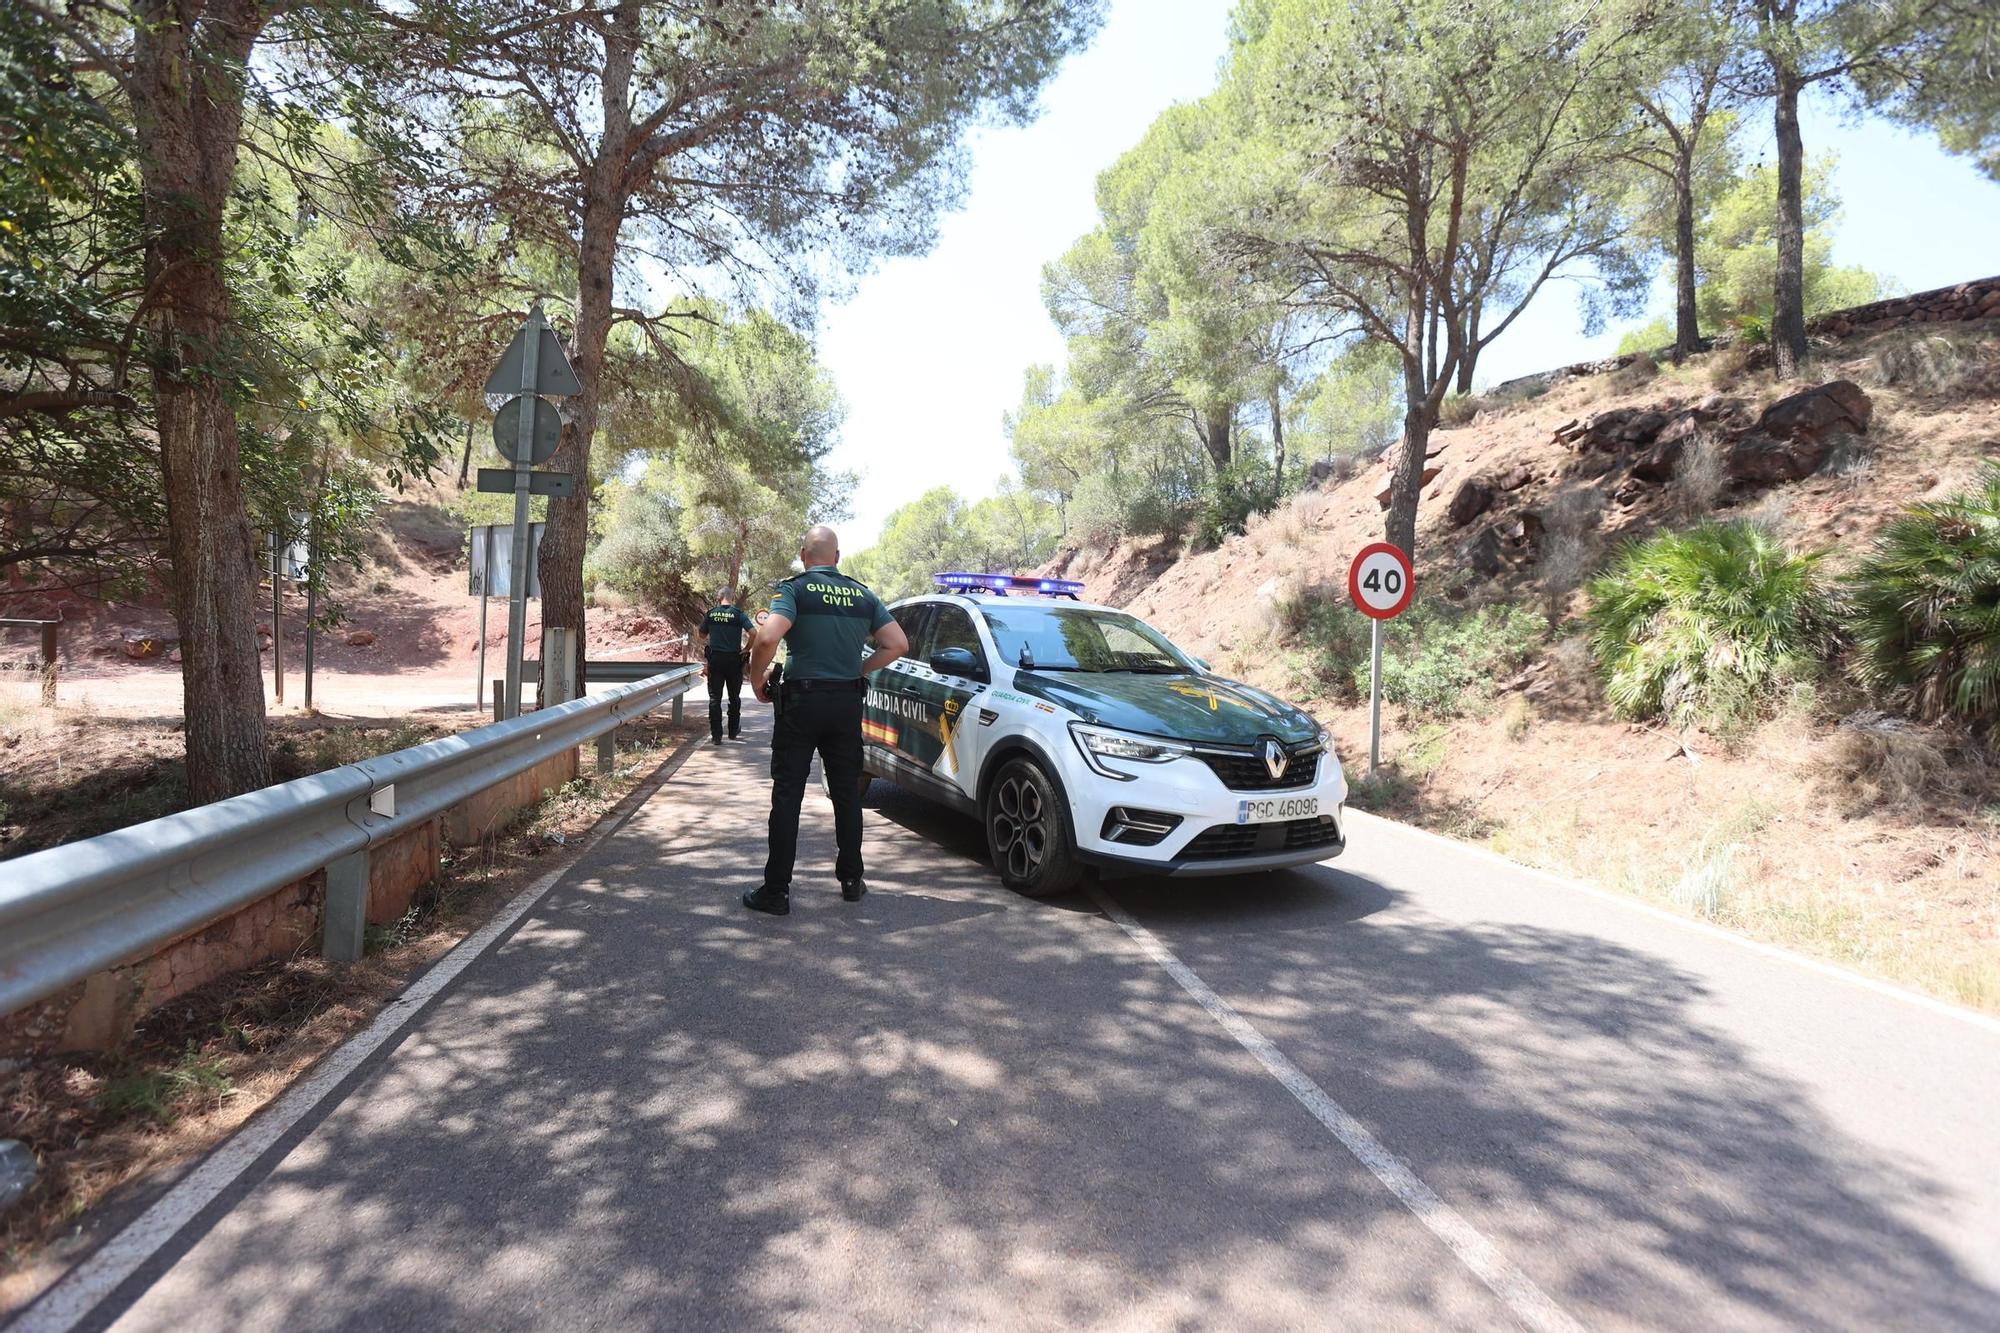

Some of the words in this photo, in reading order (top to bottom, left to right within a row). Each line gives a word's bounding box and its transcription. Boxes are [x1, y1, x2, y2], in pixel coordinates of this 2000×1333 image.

[806, 583, 864, 598] GUARDIA
[1363, 568, 1401, 594] 40
[822, 594, 854, 607] CIVIL
[902, 698, 928, 723] CIVIL
[1247, 801, 1274, 819] PGC
[1278, 798, 1318, 817] 4609G
